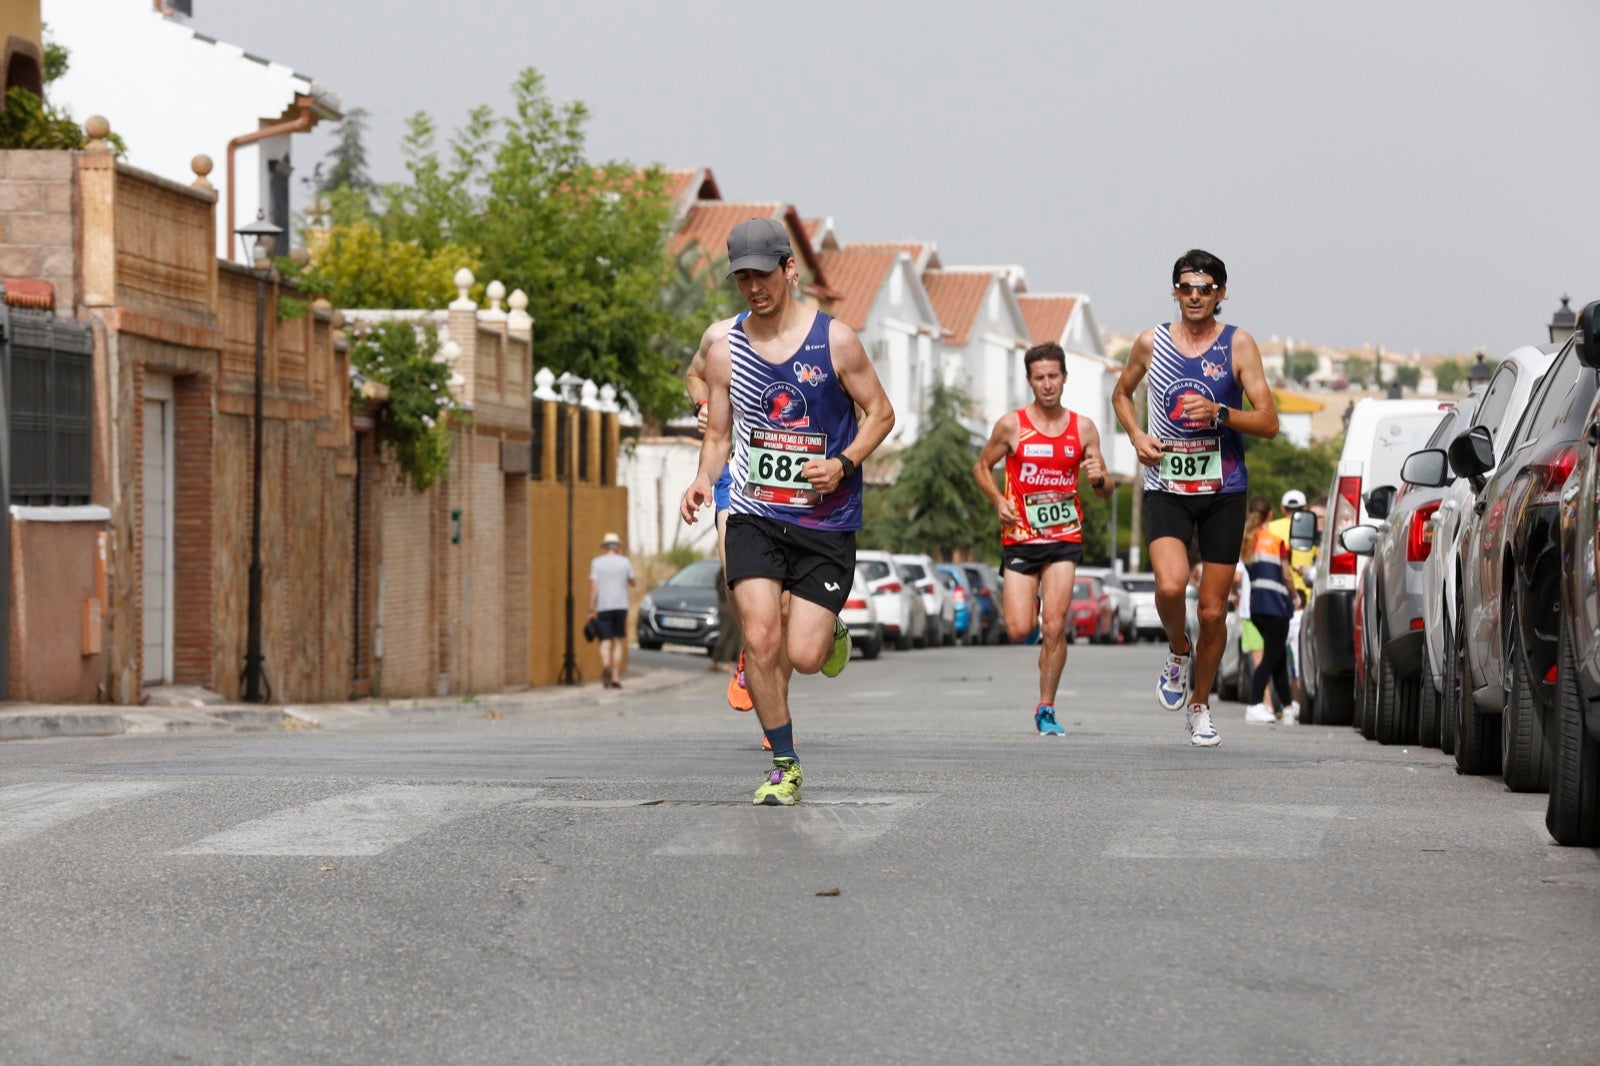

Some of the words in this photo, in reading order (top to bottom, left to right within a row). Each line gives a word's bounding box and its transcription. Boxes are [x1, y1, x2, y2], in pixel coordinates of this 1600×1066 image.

[1168, 381, 1193, 396] HUELLAS
[765, 431, 778, 441] GRAN
[778, 433, 797, 443] PREMIO
[797, 435, 805, 444] DE
[805, 436, 822, 446] FONDO
[758, 453, 811, 482] 682
[1019, 462, 1075, 486] Polisalud
[1170, 455, 1211, 477] 987
[1037, 502, 1071, 524] 605
